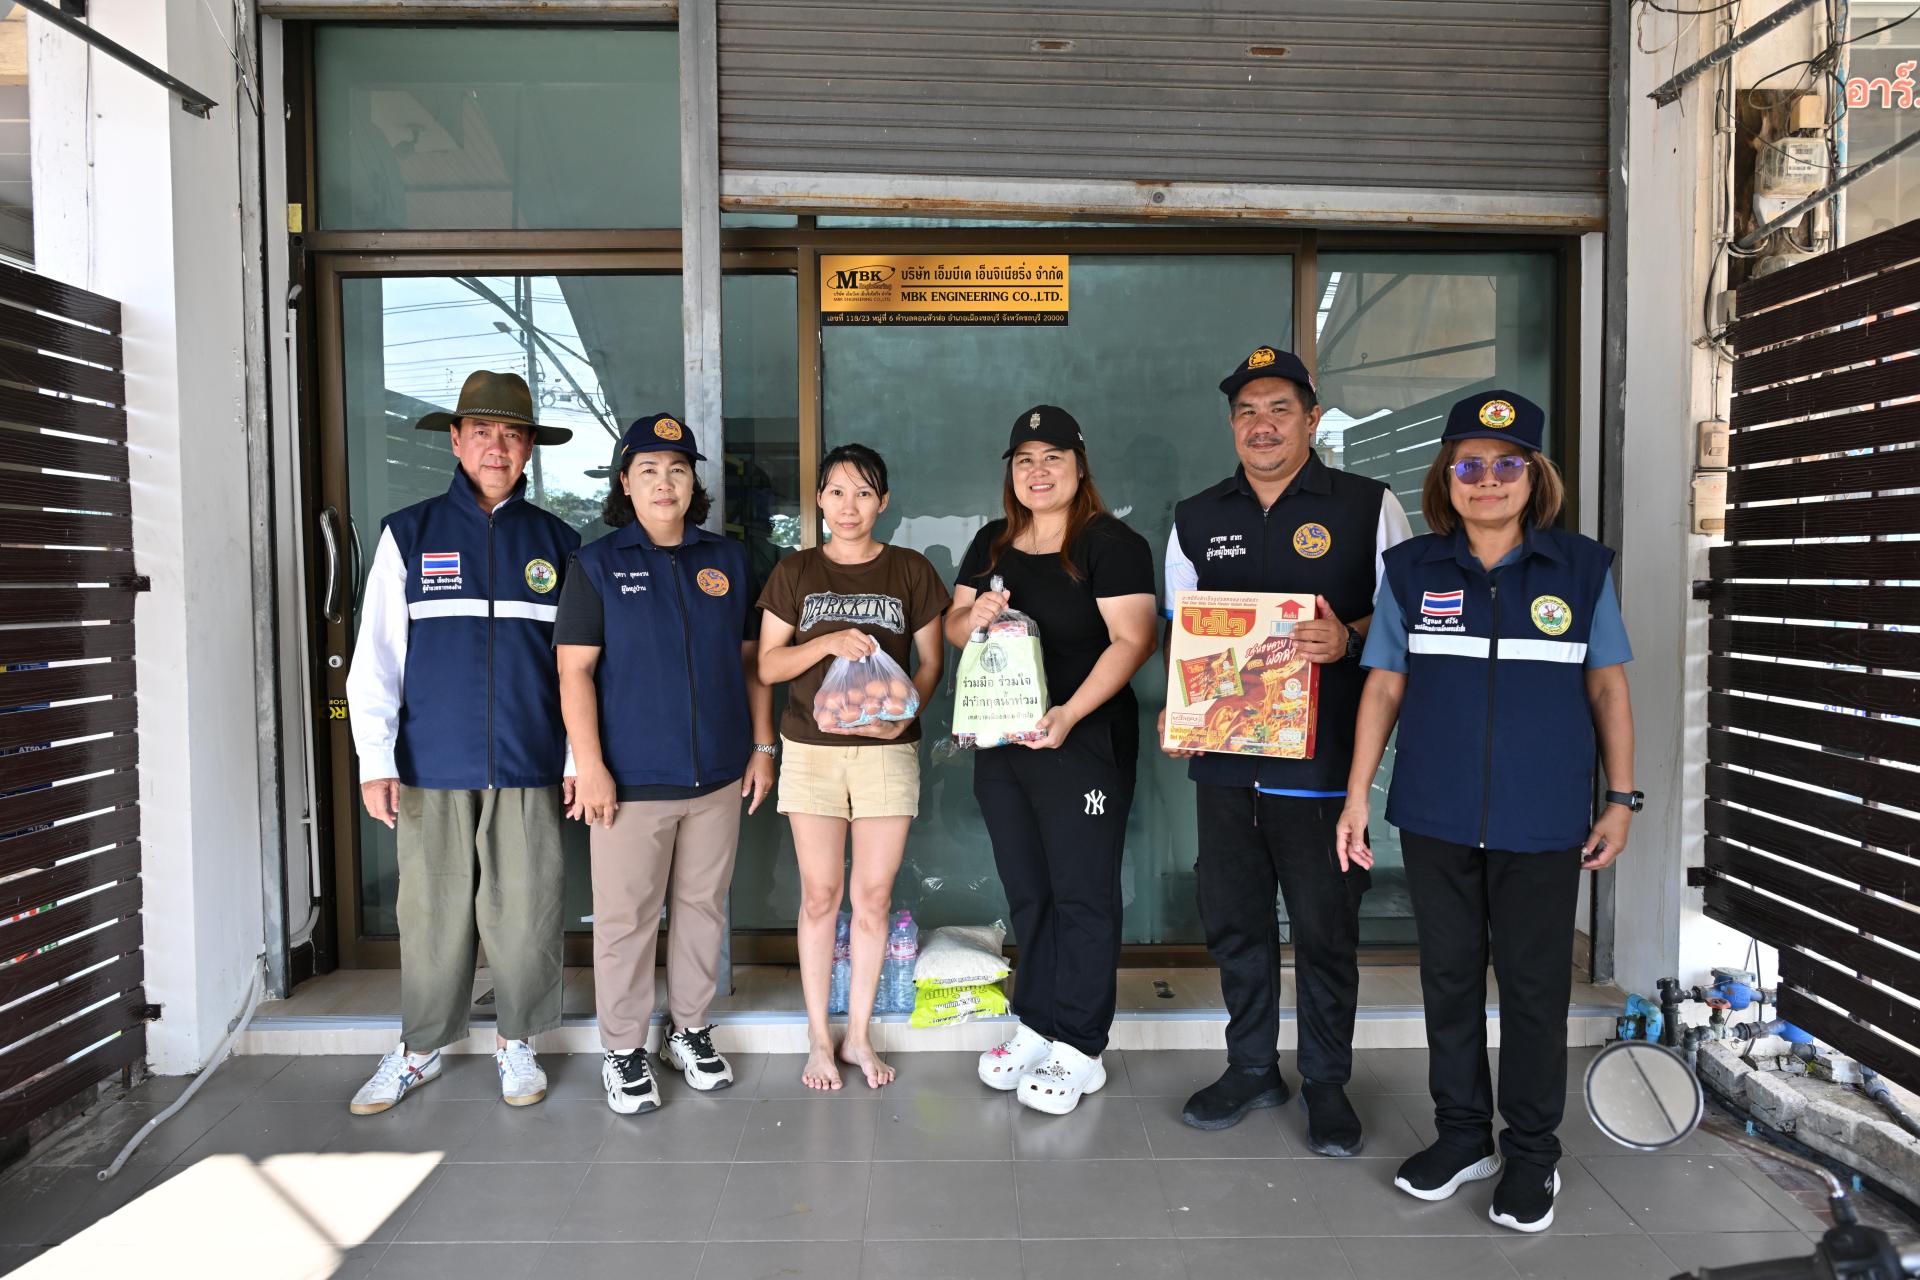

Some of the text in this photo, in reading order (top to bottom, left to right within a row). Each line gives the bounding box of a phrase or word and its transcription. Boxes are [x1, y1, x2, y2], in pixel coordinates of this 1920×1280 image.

[836, 270, 882, 289] MBK
[901, 263, 1063, 280] บริษัท เอ็มบีเค เอ็นจิเนียริ่ง จำกัด
[901, 291, 927, 302] MBK
[931, 291, 1009, 302] ENGINEERING
[1013, 291, 1063, 303] CO.,LTD.
[1043, 314, 1064, 322] 20000
[621, 584, 647, 595] ผู้ใหญ่บ้าน
[800, 596, 903, 630] DARKKINS
[1184, 609, 1247, 636] ไวไว
[962, 672, 1031, 688] ร่วมมือ ร่วมใจ
[1083, 788, 1107, 815] NY
